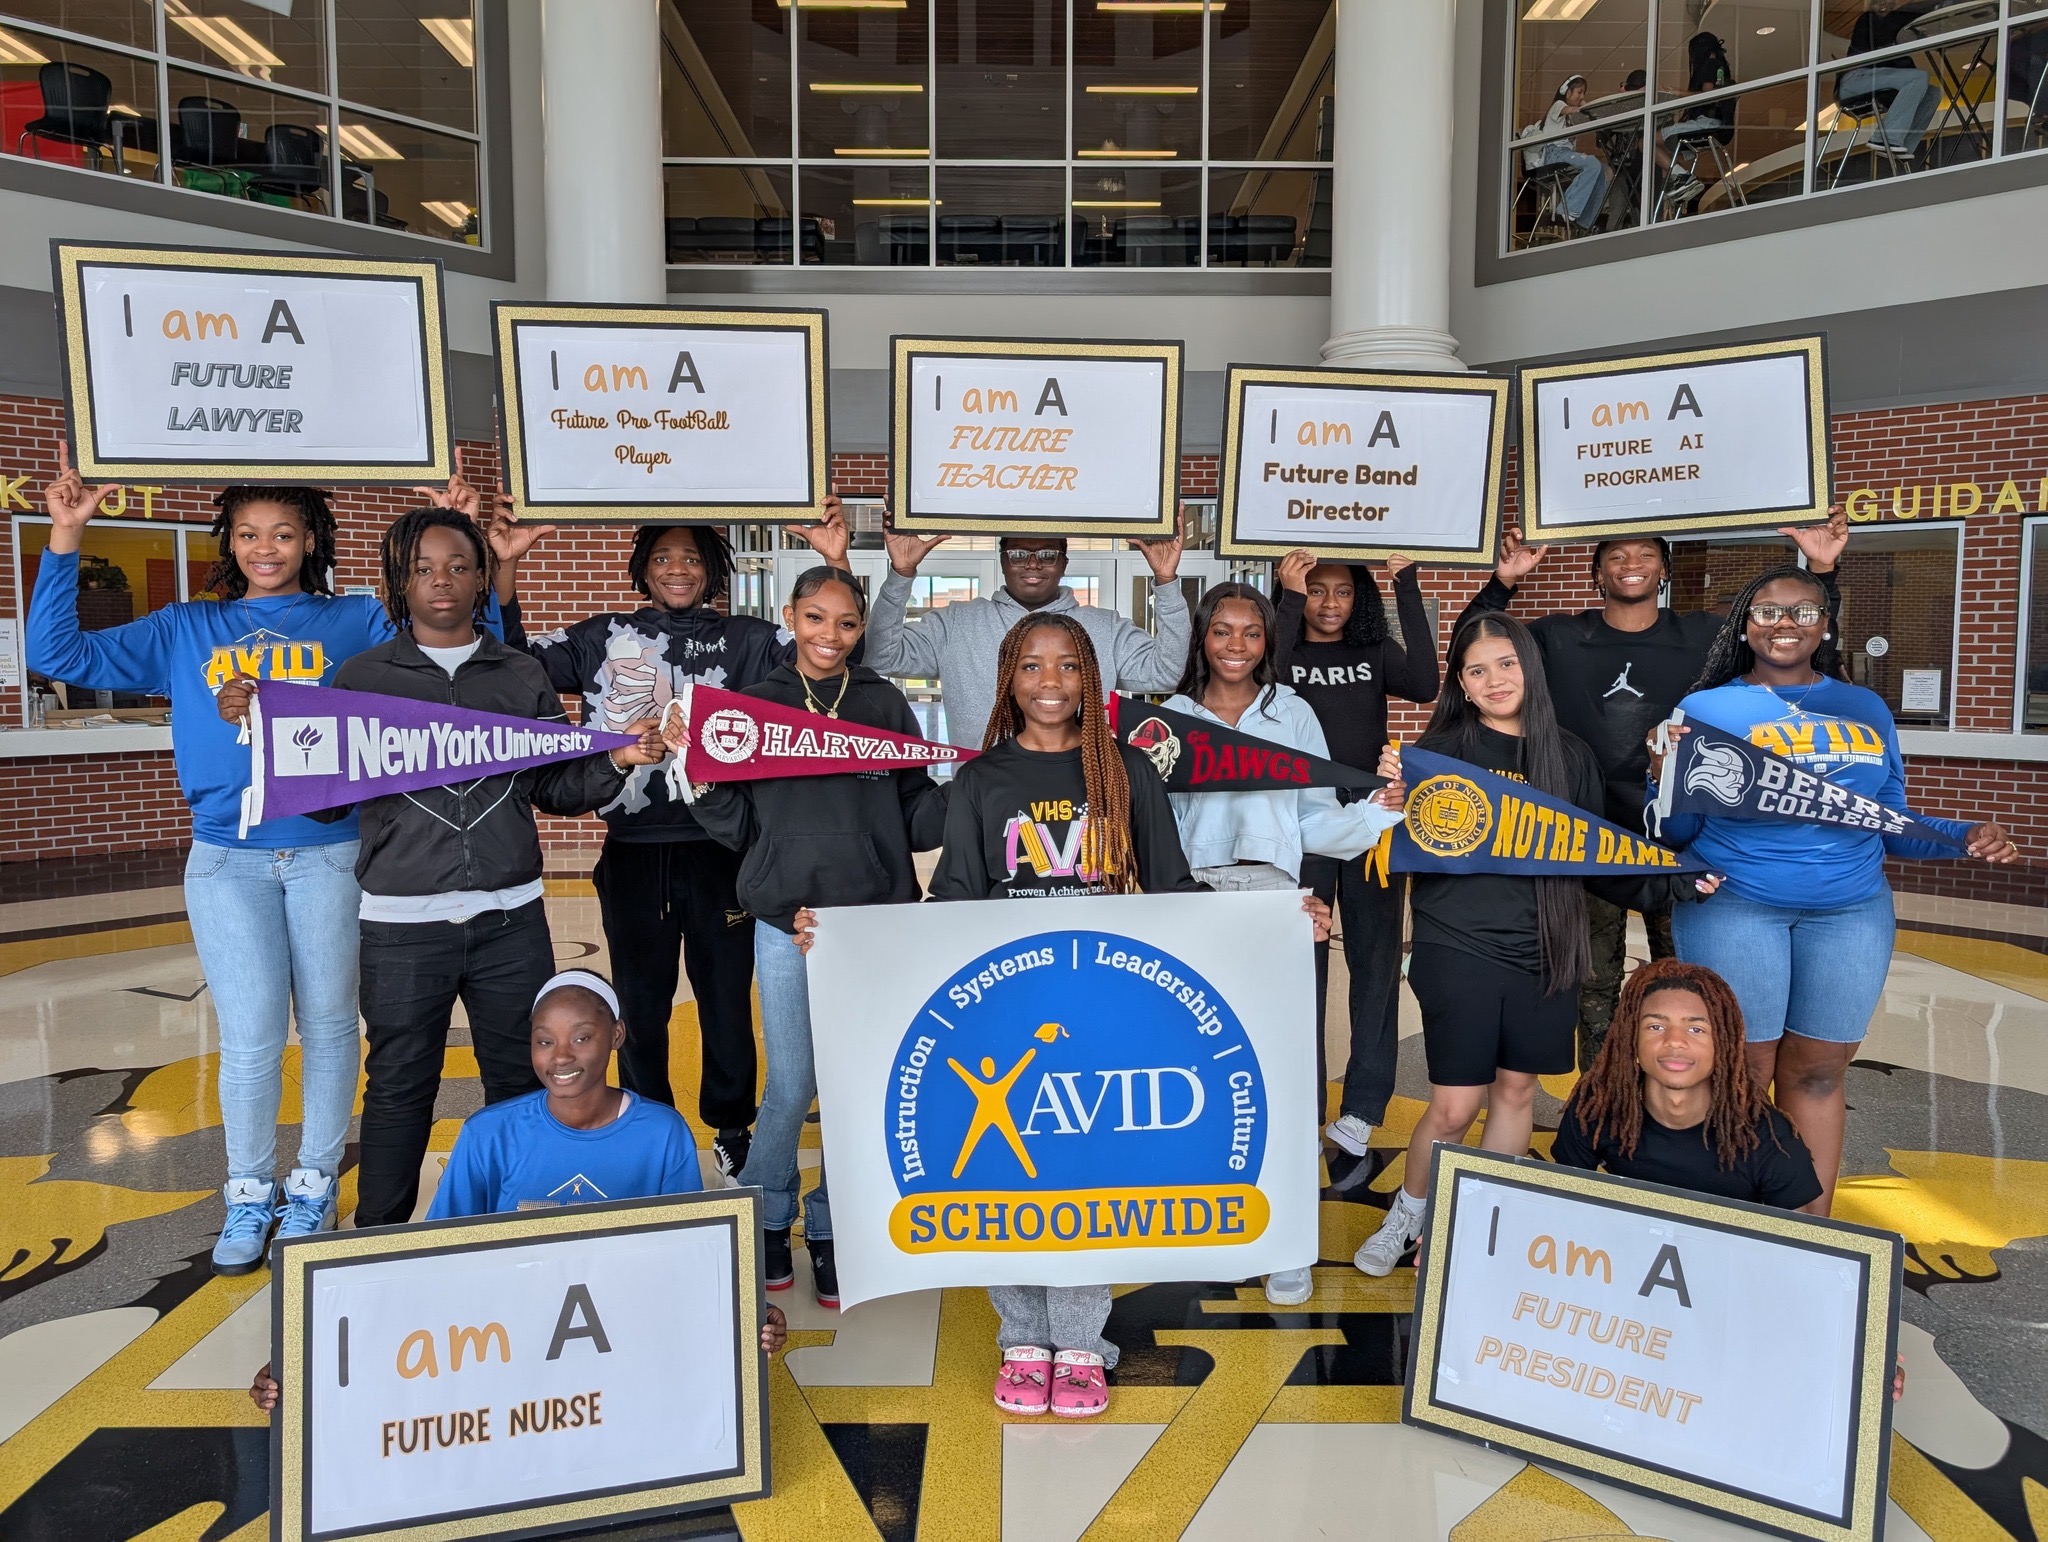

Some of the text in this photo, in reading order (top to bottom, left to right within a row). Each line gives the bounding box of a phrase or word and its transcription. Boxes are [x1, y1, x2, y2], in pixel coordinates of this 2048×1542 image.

[123, 293, 306, 345] I am A
[171, 361, 294, 390] FUTURE
[550, 349, 706, 394] I am A
[934, 374, 1069, 417] I am A
[1564, 382, 1704, 430] I am A
[166, 406, 304, 434] LAWYER
[550, 408, 731, 431] Future Pro FootBall
[1270, 408, 1401, 449] I am A
[949, 425, 1074, 453] FUTURE
[1576, 432, 1705, 461] FUTURE AI
[614, 444, 673, 475] Player
[936, 462, 1079, 491] TEACHER
[1263, 461, 1419, 487] Future Band
[1583, 463, 1701, 489] PROGRAMER
[97, 484, 163, 519] UT
[1287, 498, 1391, 522] Director
[207, 640, 324, 688] AVID
[1291, 662, 1372, 686] PARIS
[492, 725, 592, 762] University
[712, 750, 744, 762] HARVARD
[762, 722, 958, 760] HARVARD
[1750, 720, 1884, 757] AVID
[1189, 744, 1311, 784] DAWGS
[1442, 781, 1460, 790] OF
[1756, 756, 1914, 826] BERRY
[1030, 800, 1073, 822] VHS
[1411, 783, 1437, 846] UNIVERSITY
[1462, 787, 1485, 824] NOTRE
[1757, 789, 1904, 835] COLLEGE
[1451, 827, 1482, 850] DAME
[1491, 794, 1678, 867] NOTRE DAME
[1007, 888, 1046, 898] Proven
[895, 941, 1257, 1183] Instruction Systems Leadership Culture
[1019, 1067, 1205, 1136] AVID
[910, 1196, 1246, 1244] SCHOOLWIDE
[1487, 1205, 1693, 1309] I am A
[337, 1282, 613, 1388] I am A
[1512, 1291, 1672, 1360] FUTURE
[1475, 1335, 1703, 1424] PRESIDENT
[381, 1390, 603, 1459] FUTURE NURSE
